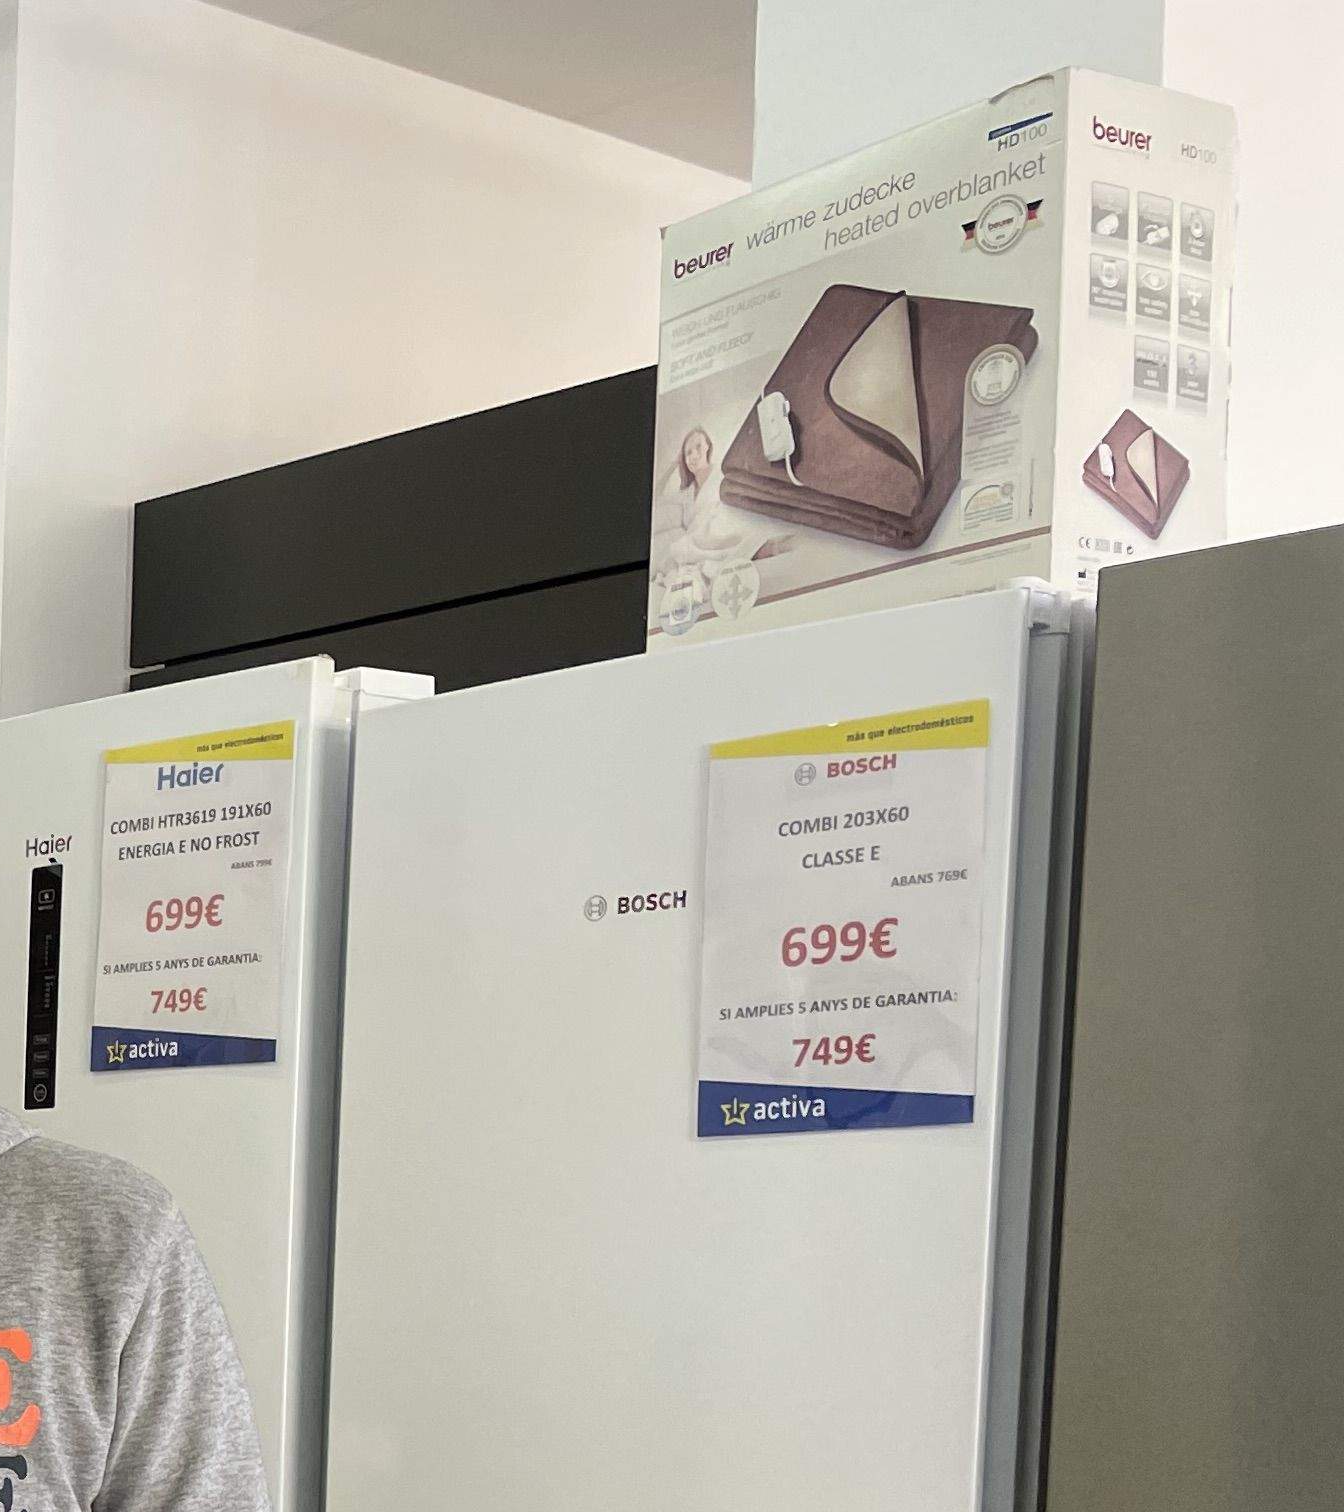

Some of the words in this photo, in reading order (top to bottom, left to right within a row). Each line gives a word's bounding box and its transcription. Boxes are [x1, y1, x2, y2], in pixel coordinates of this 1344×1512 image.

[1092, 115, 1152, 151] beurer
[746, 208, 816, 251] wärme
[822, 171, 916, 222] zudecke
[824, 205, 899, 251] heated
[908, 155, 1046, 220] overblanket
[674, 241, 735, 279] beurer
[867, 729, 885, 740] que
[157, 762, 224, 791] Haier
[826, 753, 898, 779] BOSCH
[110, 815, 154, 835] COMBI
[158, 807, 216, 830] HTR3619
[221, 801, 272, 822] 191X60
[778, 817, 838, 838] COMBI
[843, 806, 910, 830] 203X60
[25, 835, 72, 858] Haier
[118, 843, 175, 862] ENERGIA
[179, 841, 187, 854] E
[190, 837, 212, 852] NO
[216, 831, 260, 850] FROST
[802, 848, 865, 869] CLASSE
[870, 846, 881, 862] E
[891, 872, 933, 888] ABANS
[938, 869, 969, 883] 769€
[146, 894, 225, 934] 699€
[617, 890, 688, 916] BOSCH
[781, 917, 899, 968] 699€
[103, 964, 111, 975] SI
[113, 960, 153, 974] AMPLIES
[156, 960, 162, 970] 5
[164, 957, 190, 970] ANYS
[192, 956, 205, 968] DE
[151, 987, 208, 1014] 749€
[719, 1008, 732, 1021] SI
[735, 1001, 795, 1019] AMPLIES
[798, 1000, 807, 1015] 5
[811, 997, 848, 1014] ANYS
[852, 995, 872, 1010] DE
[129, 1039, 178, 1060] activa
[792, 1033, 877, 1069] 749€
[753, 1096, 826, 1121] activa
